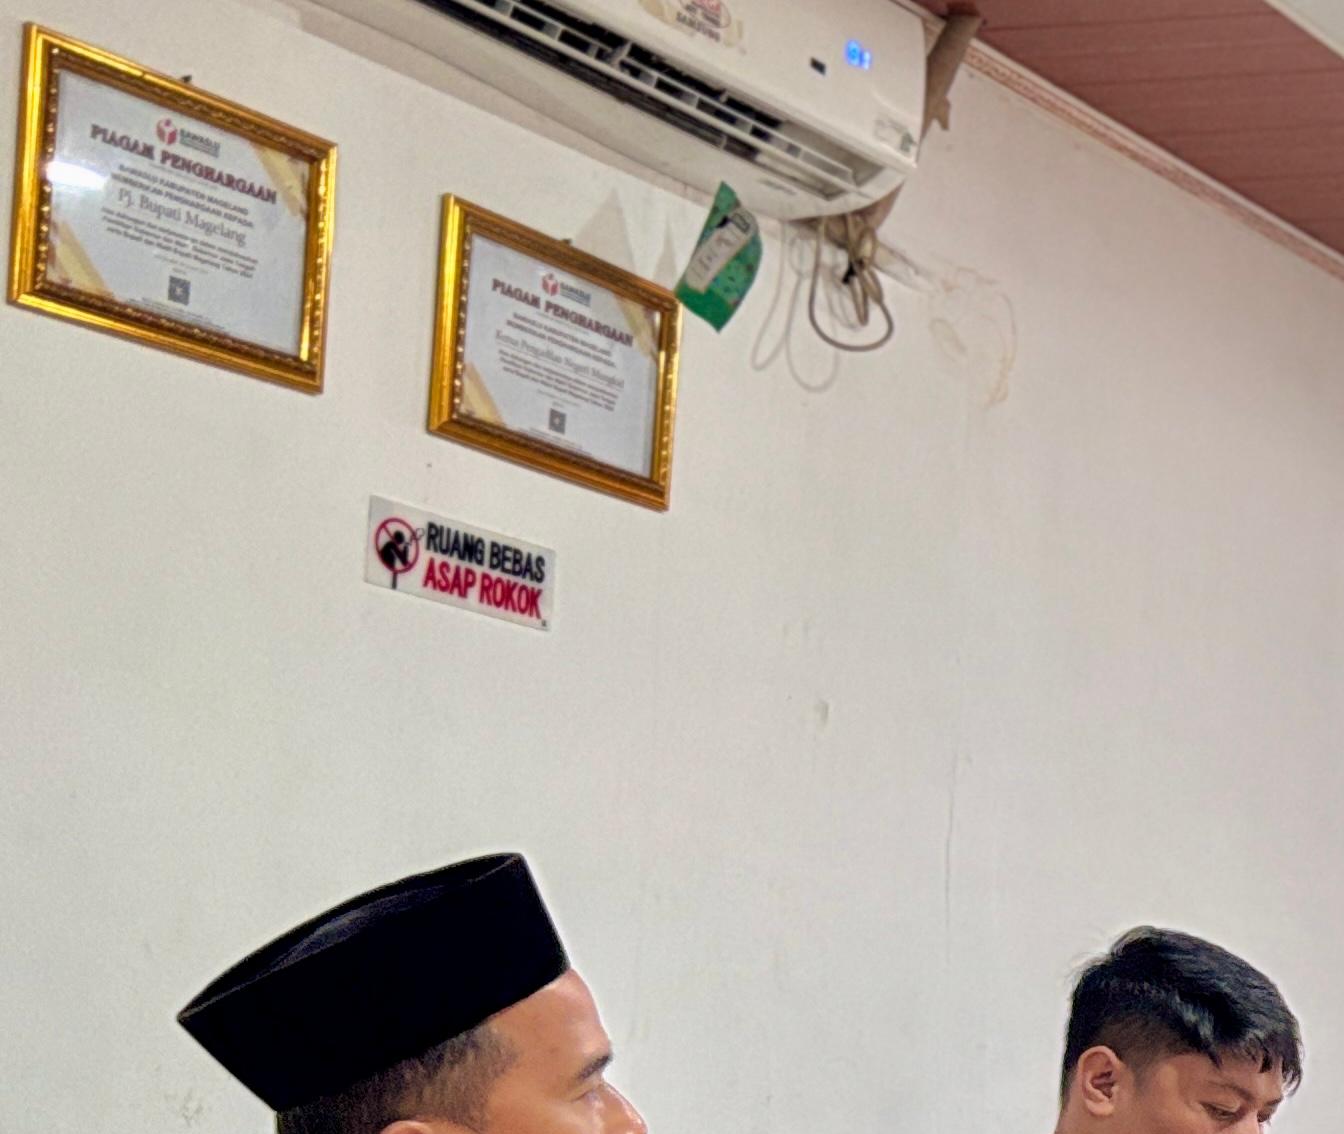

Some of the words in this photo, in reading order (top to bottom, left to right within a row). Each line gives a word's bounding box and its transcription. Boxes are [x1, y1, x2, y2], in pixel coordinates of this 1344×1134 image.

[90, 123, 155, 160] PIAGAM
[159, 149, 278, 205] PENGHARGAAN
[139, 194, 181, 221] Bupati
[184, 211, 247, 248] Magelang
[491, 278, 541, 309] PIAGAM
[544, 300, 634, 347] PENGHARGAAN
[426, 521, 485, 566] RUANG
[488, 541, 546, 583] BEBAS
[422, 557, 477, 599] ASAP
[479, 572, 543, 619] ROKOK
